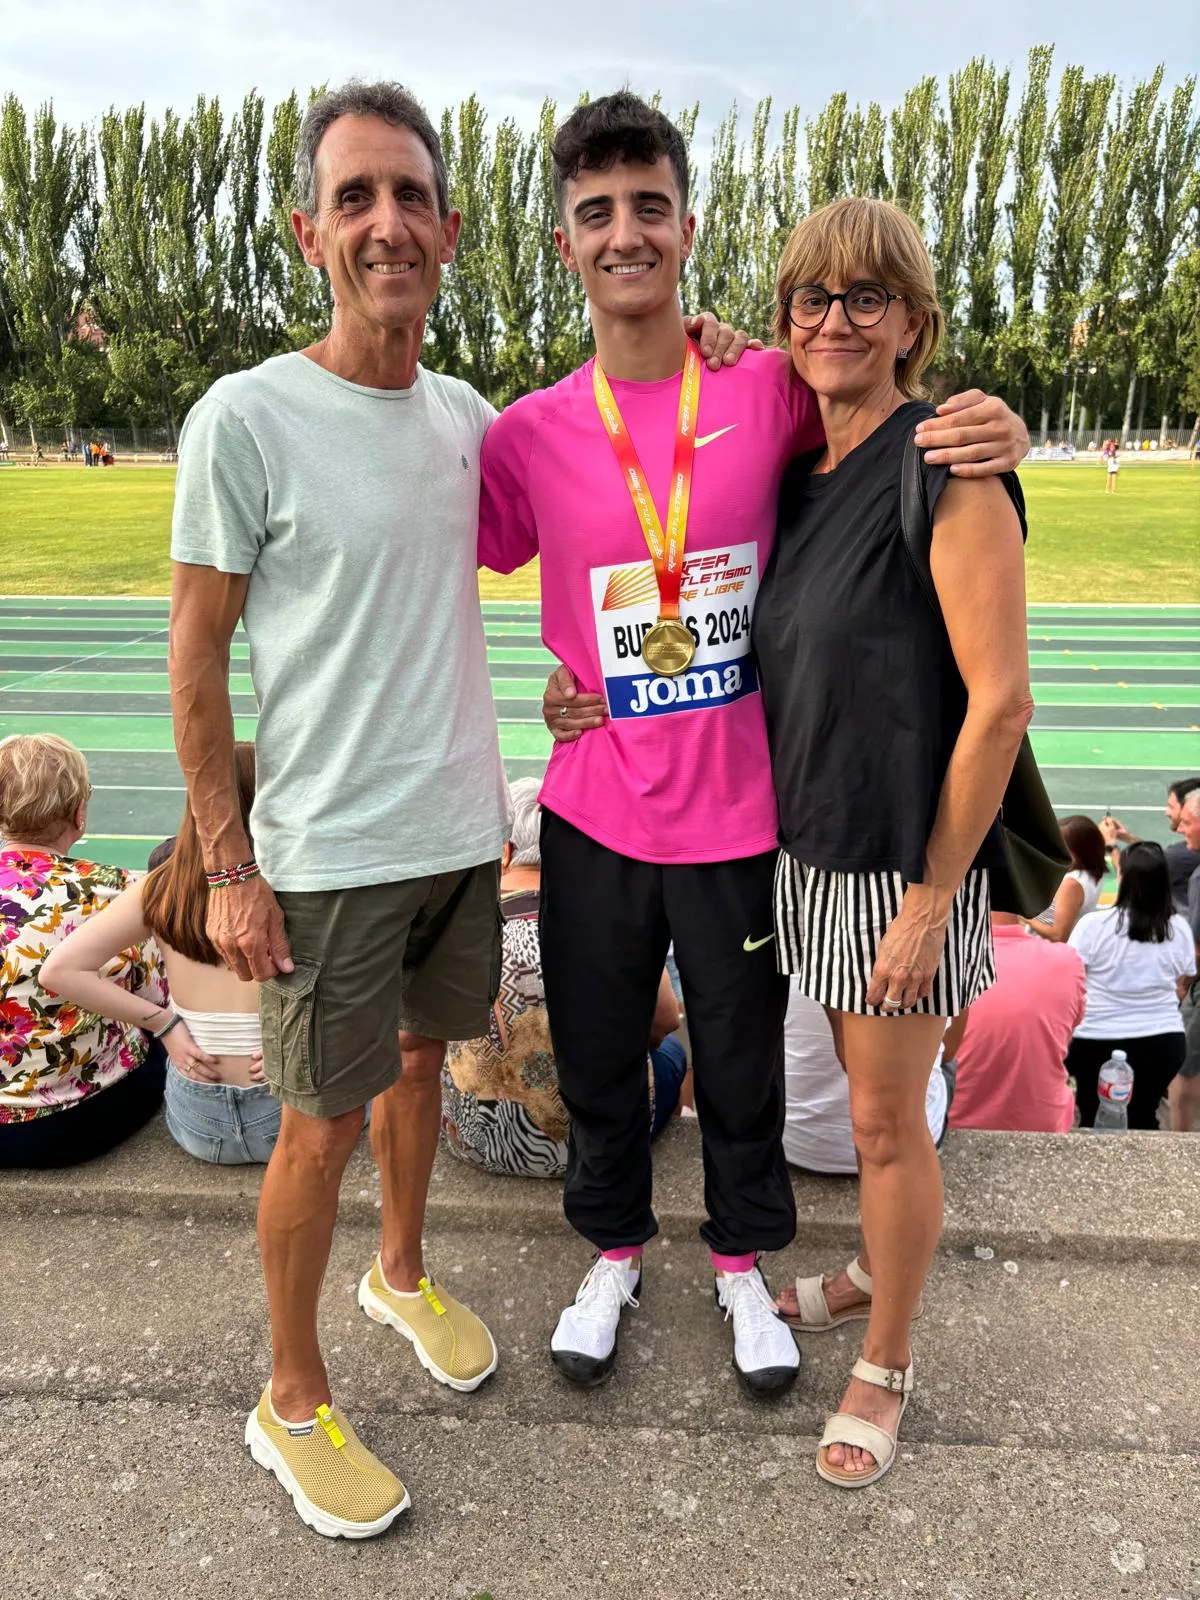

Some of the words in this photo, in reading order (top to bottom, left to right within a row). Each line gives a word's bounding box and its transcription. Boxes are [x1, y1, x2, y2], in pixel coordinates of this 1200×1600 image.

[671, 472, 684, 536] ATLETISMO
[648, 528, 664, 560] RFEA
[668, 539, 677, 573] RFEA
[679, 589, 699, 602] RE
[704, 580, 745, 597] LIBRE
[680, 565, 752, 587] TLETISMO
[705, 604, 750, 647] 2024
[629, 665, 743, 713] Joma
